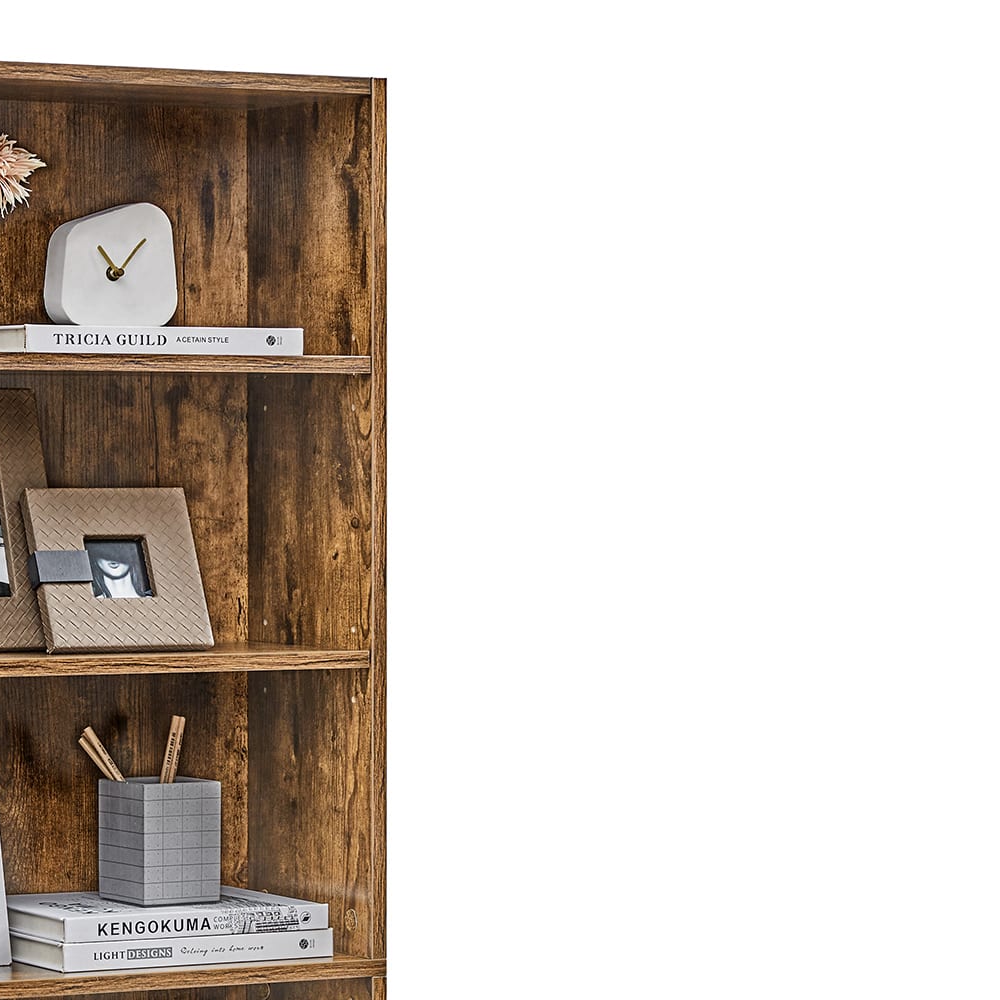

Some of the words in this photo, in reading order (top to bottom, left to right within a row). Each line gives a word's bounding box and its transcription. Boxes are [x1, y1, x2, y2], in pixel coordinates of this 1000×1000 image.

[53, 333, 111, 345] TRICIA
[116, 333, 167, 346] GUILD
[207, 336, 229, 344] STYLE
[97, 917, 211, 937] KENGOKUMA
[93, 950, 126, 961] LIGHT
[128, 947, 172, 960] DESIGNS
